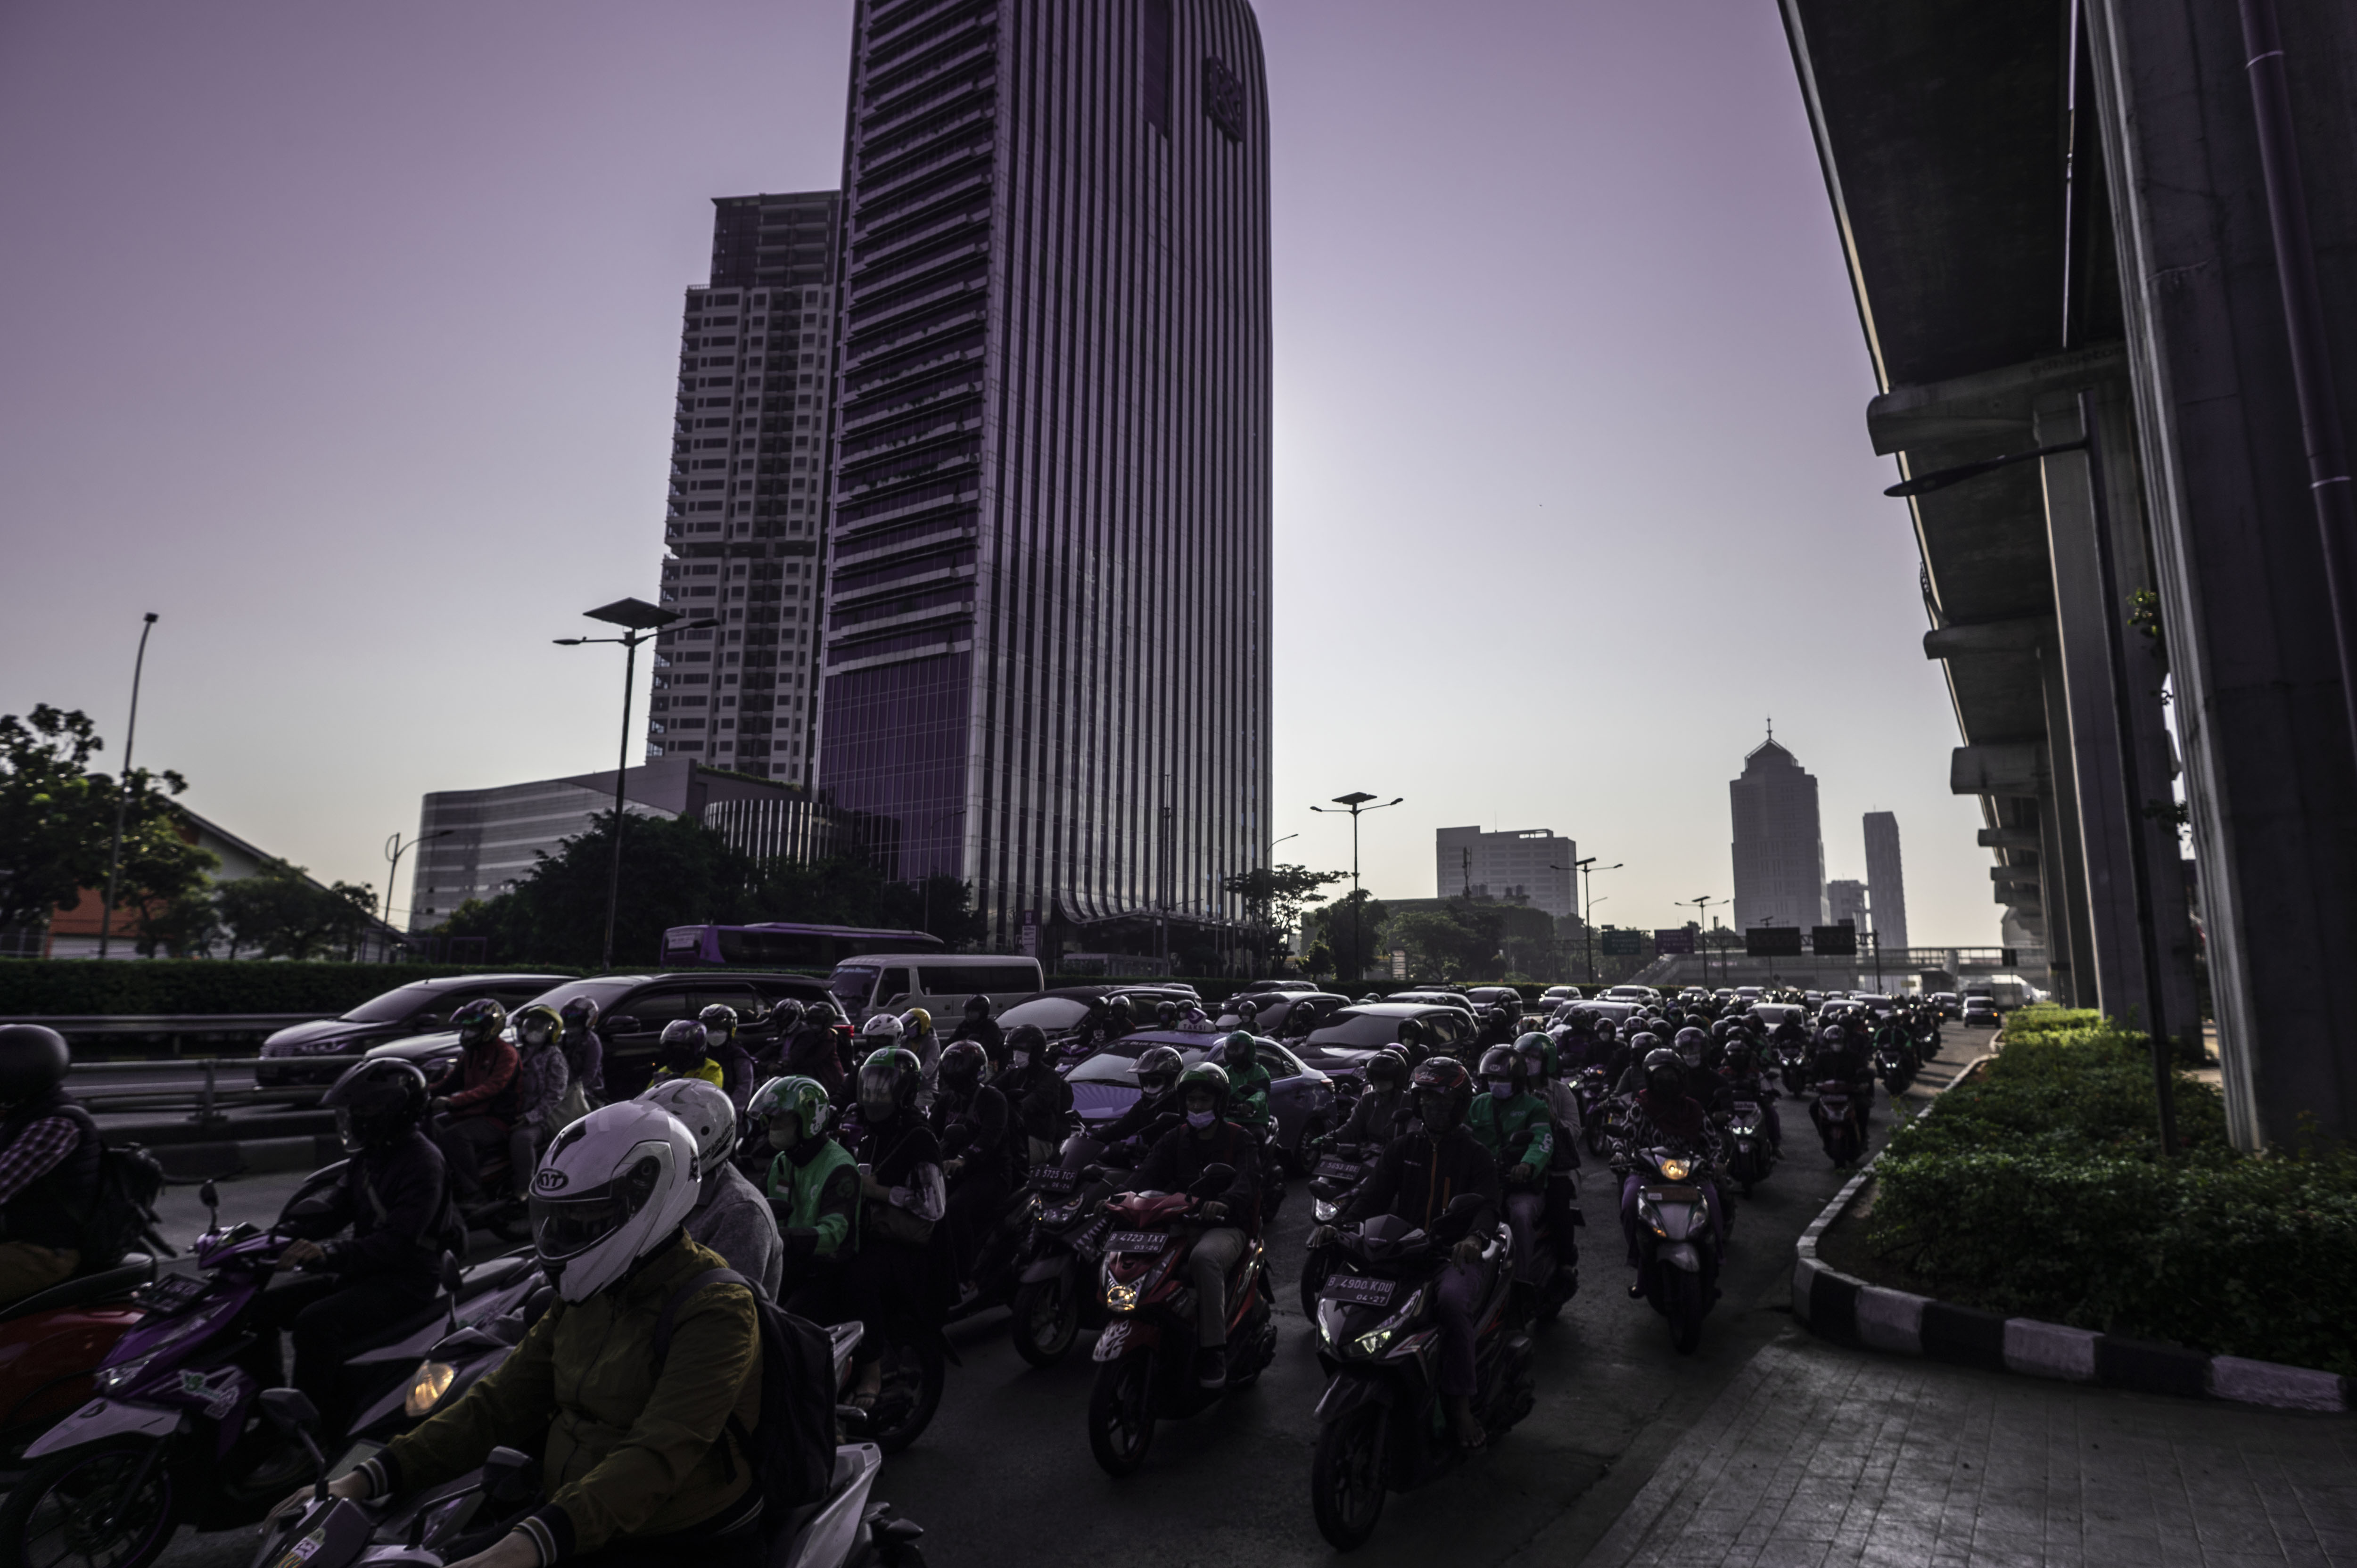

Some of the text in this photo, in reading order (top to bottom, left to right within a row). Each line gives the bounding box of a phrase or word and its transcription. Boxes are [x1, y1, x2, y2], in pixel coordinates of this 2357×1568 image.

[1042, 1169, 1060, 1179] 5725
[1062, 1171, 1075, 1180] TCF
[1110, 1233, 1165, 1243] B 4723 TXT
[1328, 1277, 1393, 1293] B 4900 KDU
